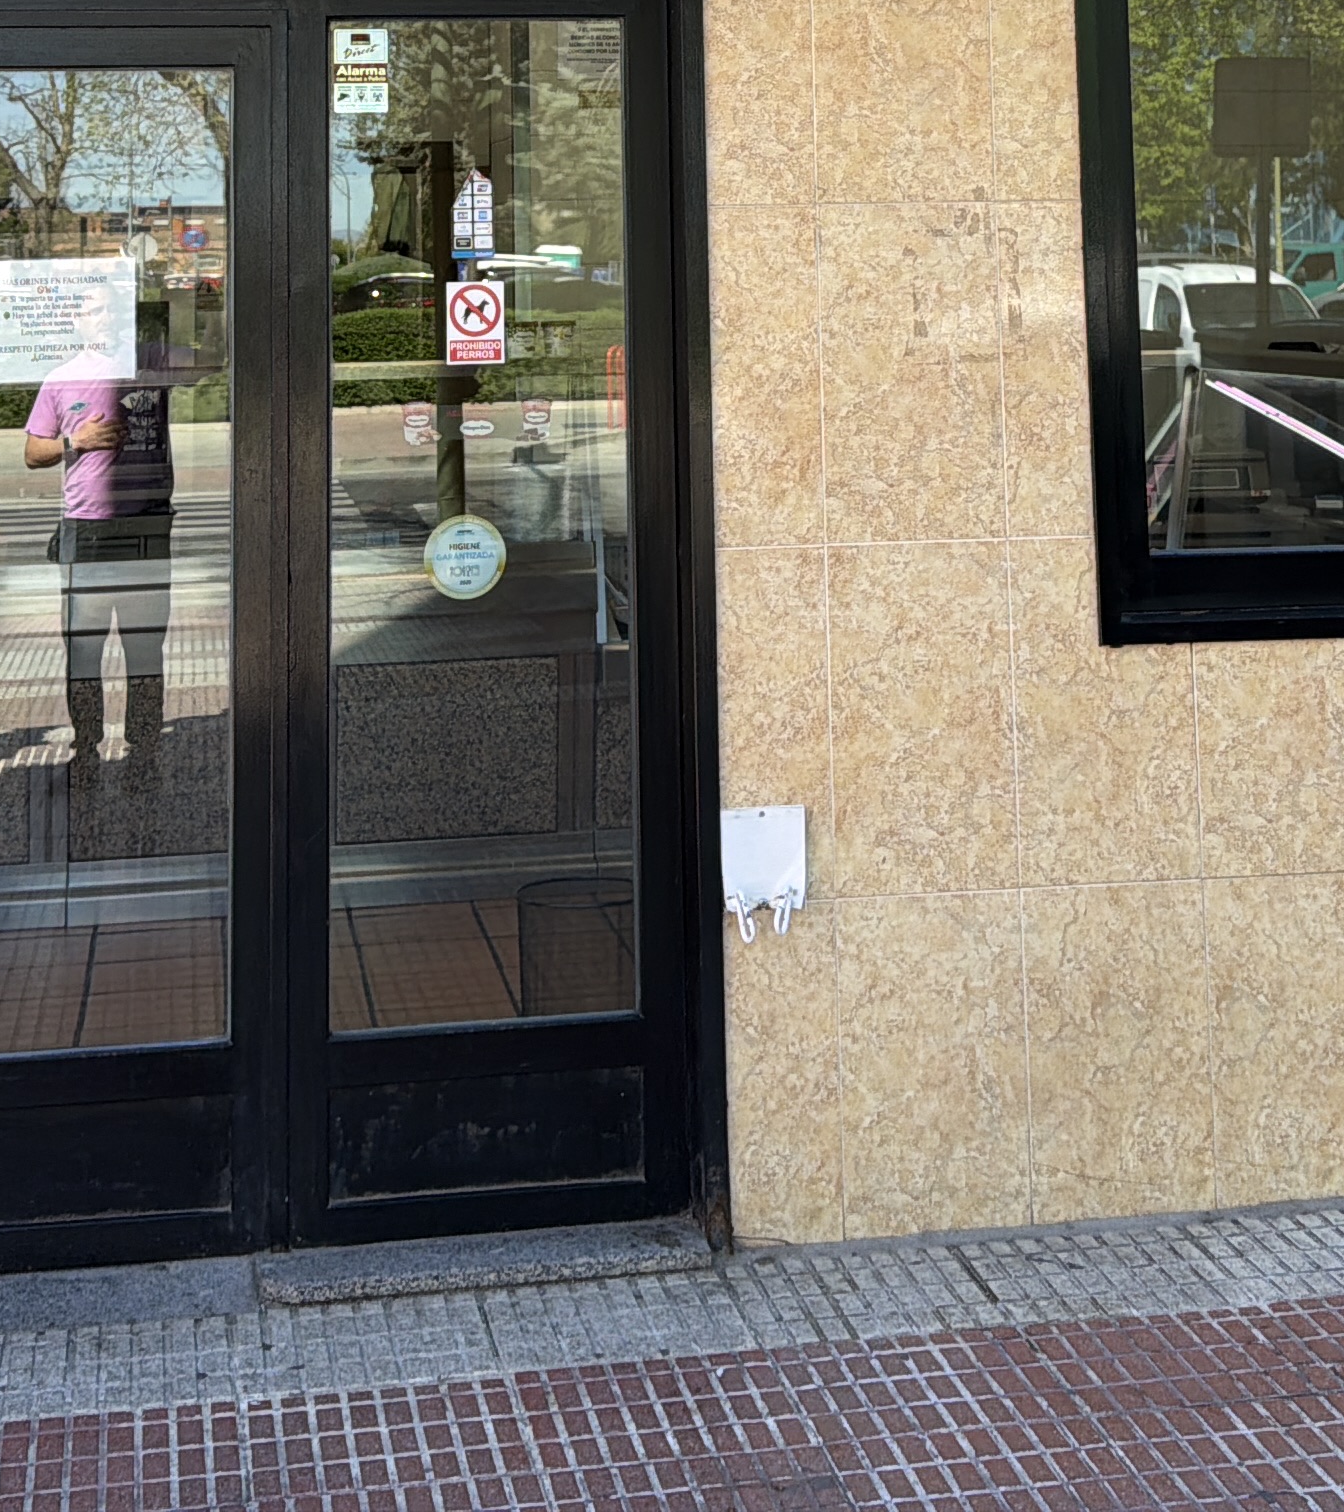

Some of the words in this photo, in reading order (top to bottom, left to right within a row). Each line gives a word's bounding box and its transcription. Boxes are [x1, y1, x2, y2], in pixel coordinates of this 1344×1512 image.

[336, 64, 386, 76] Alarma
[19, 277, 49, 285] ORINES
[33, 344, 68, 352] EMPIEZA
[69, 343, 85, 351] POR
[450, 342, 501, 350] PROHIBIDO
[456, 350, 495, 359] PERROS
[449, 542, 481, 550] HIGIENE
[436, 551, 495, 561] GARANTIZADA
